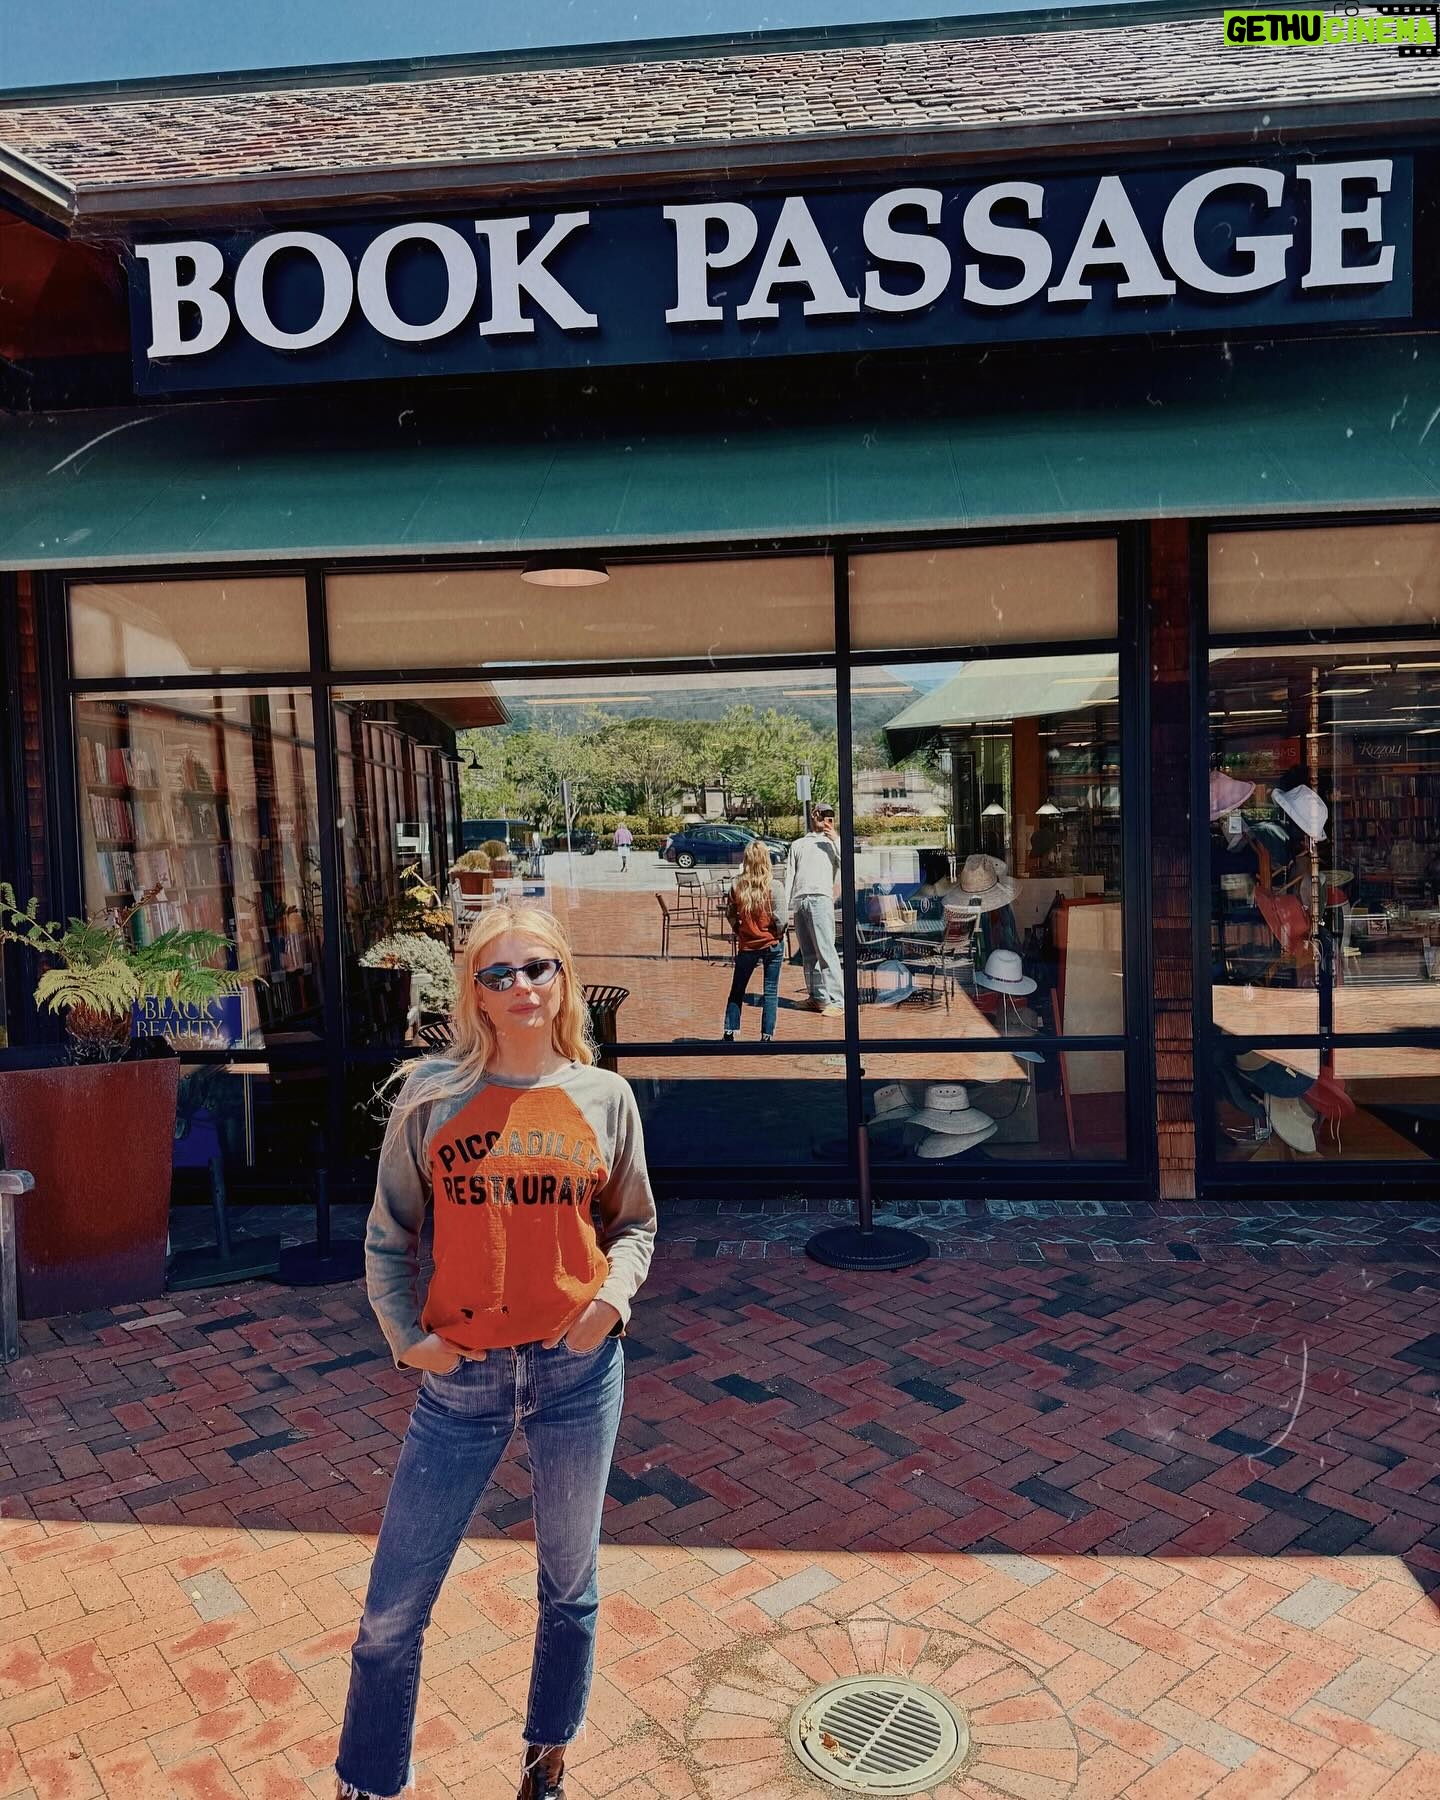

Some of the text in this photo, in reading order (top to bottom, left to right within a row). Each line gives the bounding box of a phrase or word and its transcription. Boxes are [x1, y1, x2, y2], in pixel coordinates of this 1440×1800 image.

[135, 159, 1396, 359] BOOK PASSAGE
[145, 1000, 214, 1020] BLACK
[137, 1020, 223, 1040] BEAUTY
[438, 1130, 600, 1173] PICCADILLY
